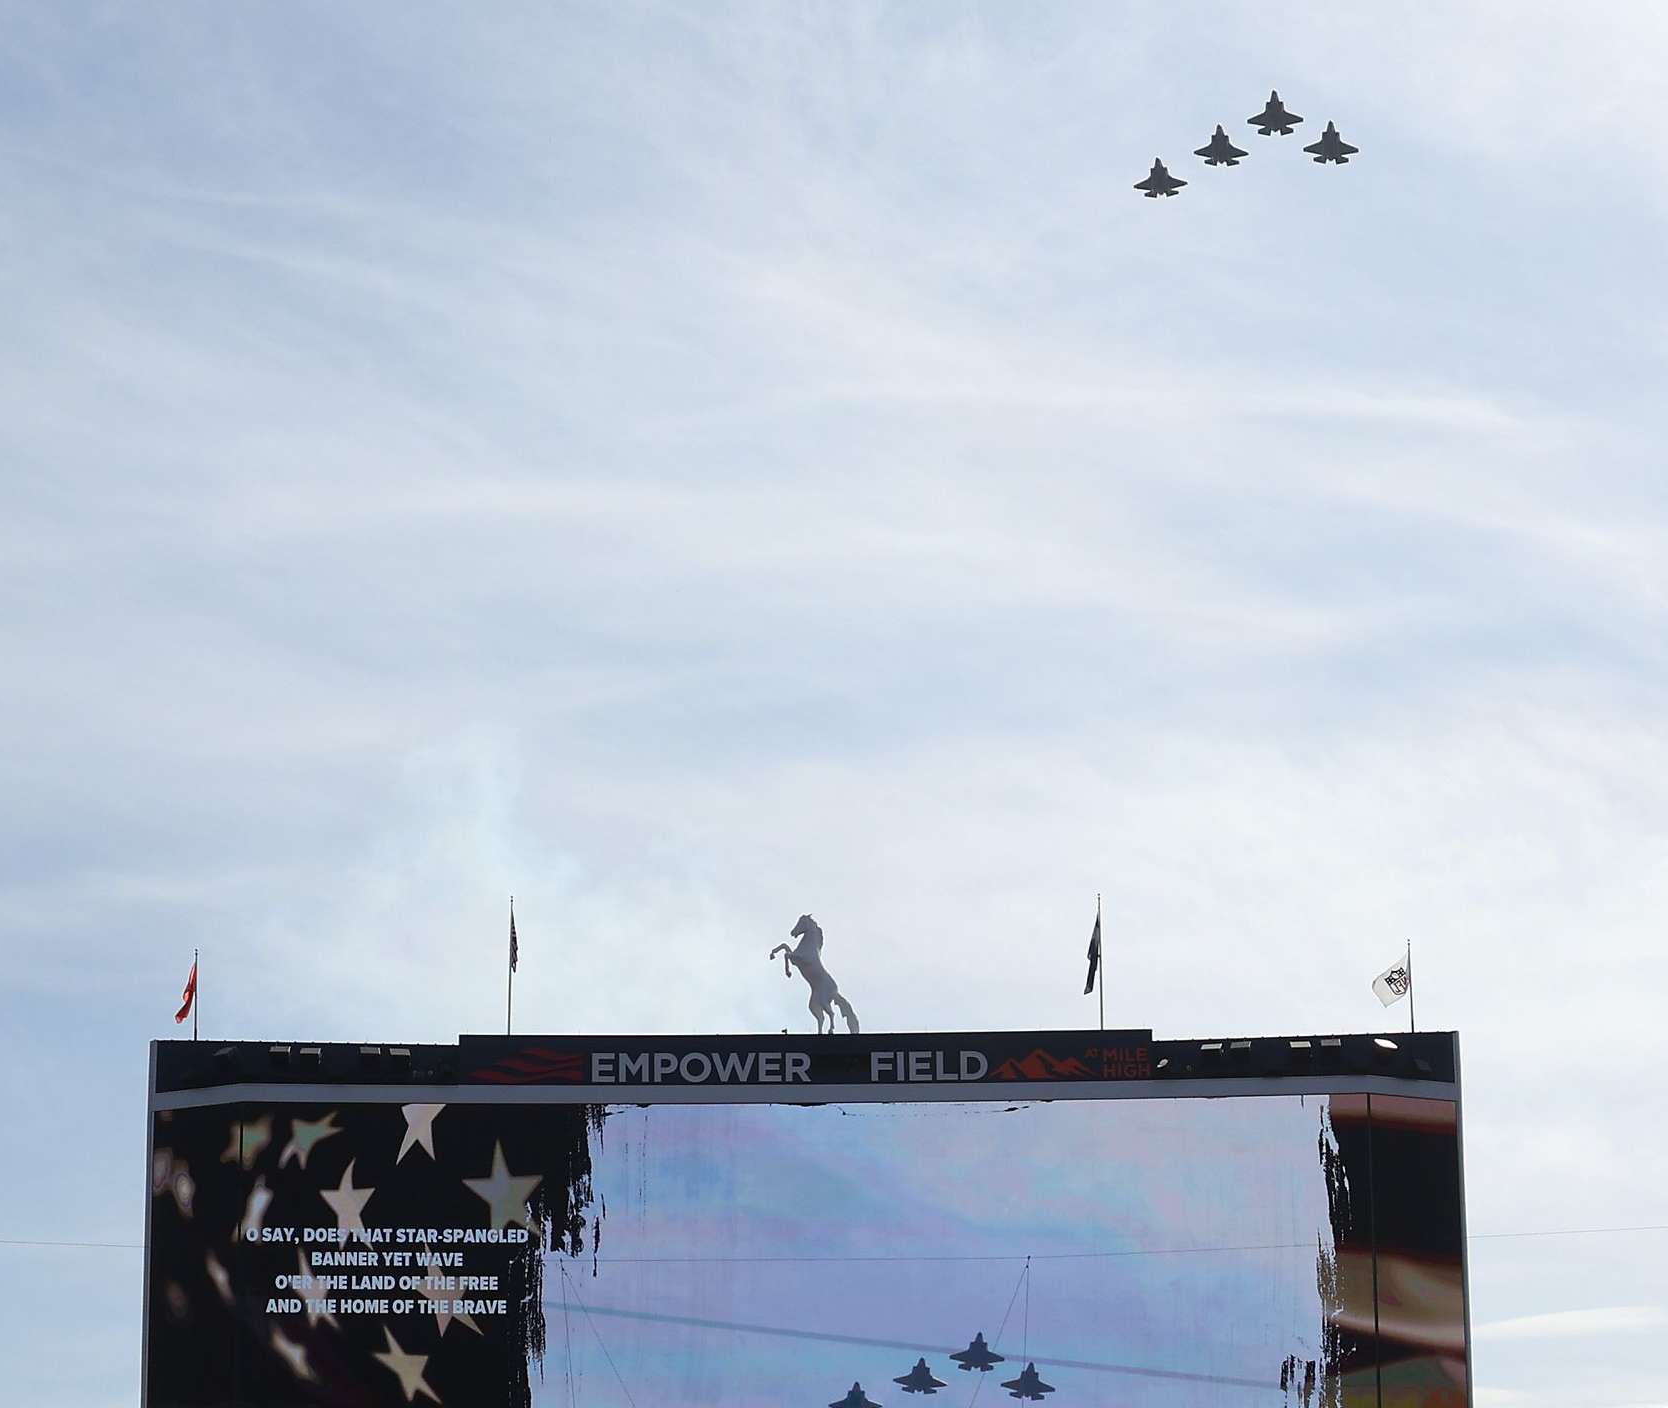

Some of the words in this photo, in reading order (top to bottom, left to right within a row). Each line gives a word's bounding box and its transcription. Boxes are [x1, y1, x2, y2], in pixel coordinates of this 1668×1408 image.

[1103, 1047, 1148, 1062] MILE
[591, 1052, 812, 1083] EMPOWER
[871, 1050, 988, 1081] FIELD
[1103, 1063, 1150, 1079] HIGH
[246, 1229, 258, 1243] O
[262, 1228, 300, 1245] SAY,
[304, 1228, 344, 1243] DOES
[350, 1228, 392, 1243] THAT
[396, 1228, 529, 1244] STAR-SPANGLED
[311, 1252, 379, 1267] BANNER
[382, 1252, 411, 1267] YET
[415, 1252, 464, 1267] WAVE
[275, 1275, 314, 1290] O'ER
[317, 1275, 348, 1290] THE
[351, 1275, 395, 1290] LAND
[399, 1275, 421, 1290] OF
[424, 1275, 454, 1290] THE
[459, 1275, 499, 1291] FREE
[266, 1299, 301, 1314] AND
[306, 1299, 337, 1314] THE
[340, 1299, 389, 1314] HOME
[392, 1299, 414, 1314] OF
[418, 1299, 449, 1314] THE
[452, 1299, 507, 1314] BRAVE
